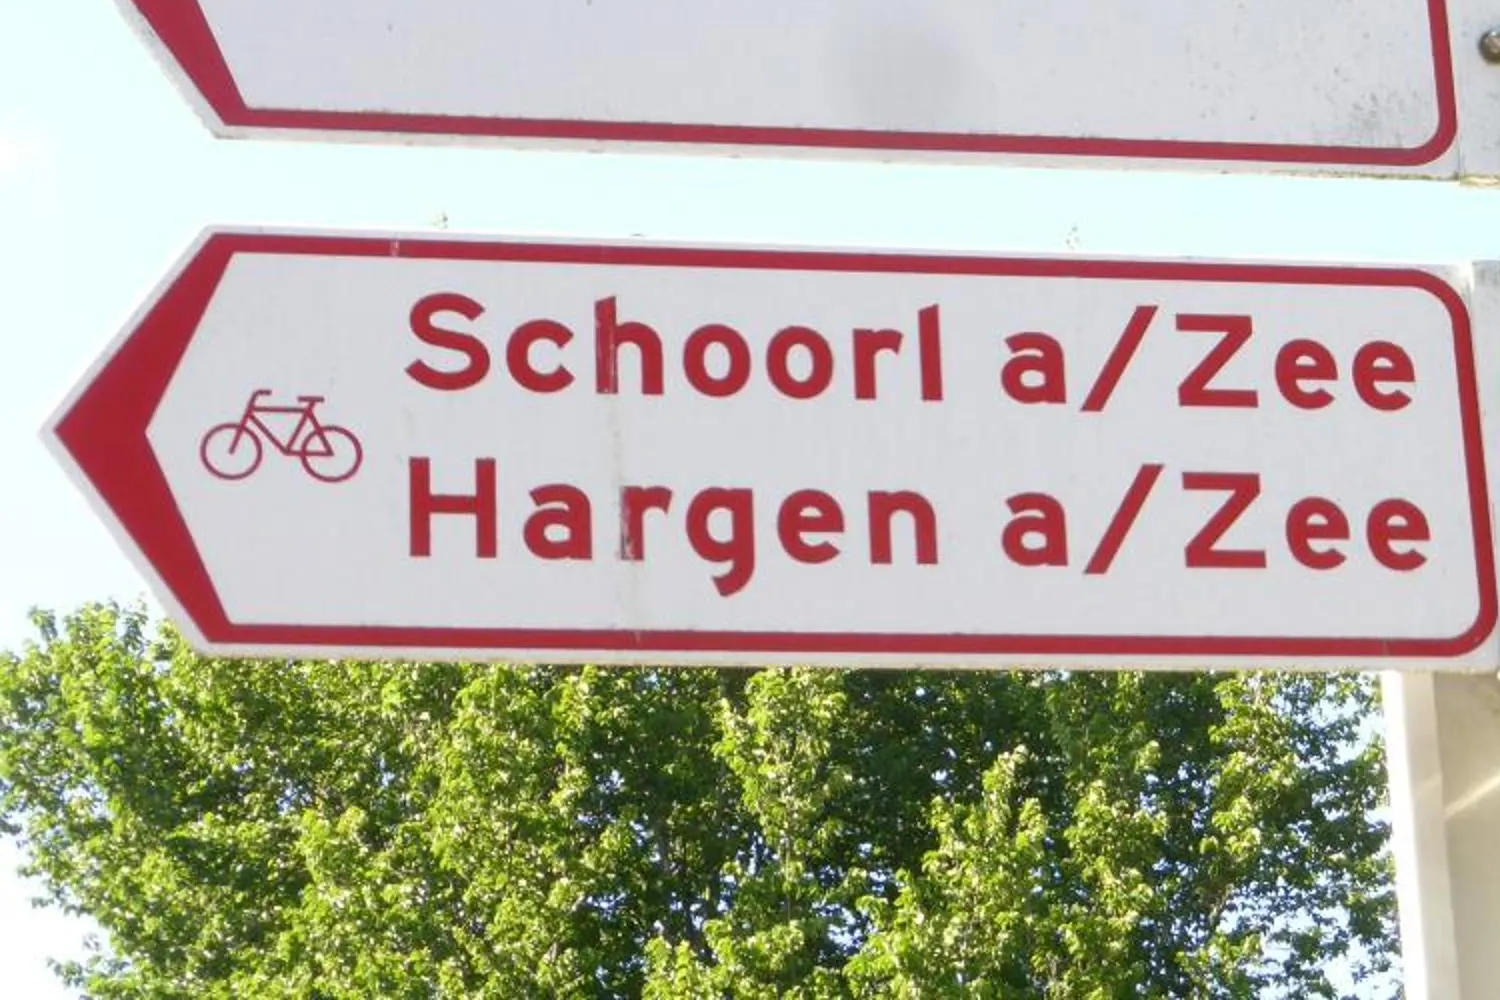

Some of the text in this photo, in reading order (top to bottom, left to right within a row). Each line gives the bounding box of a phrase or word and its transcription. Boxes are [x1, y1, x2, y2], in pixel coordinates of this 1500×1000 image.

[406, 292, 1418, 415] Schoorl a/Zee
[408, 456, 1434, 598] Hargen a/Zee
